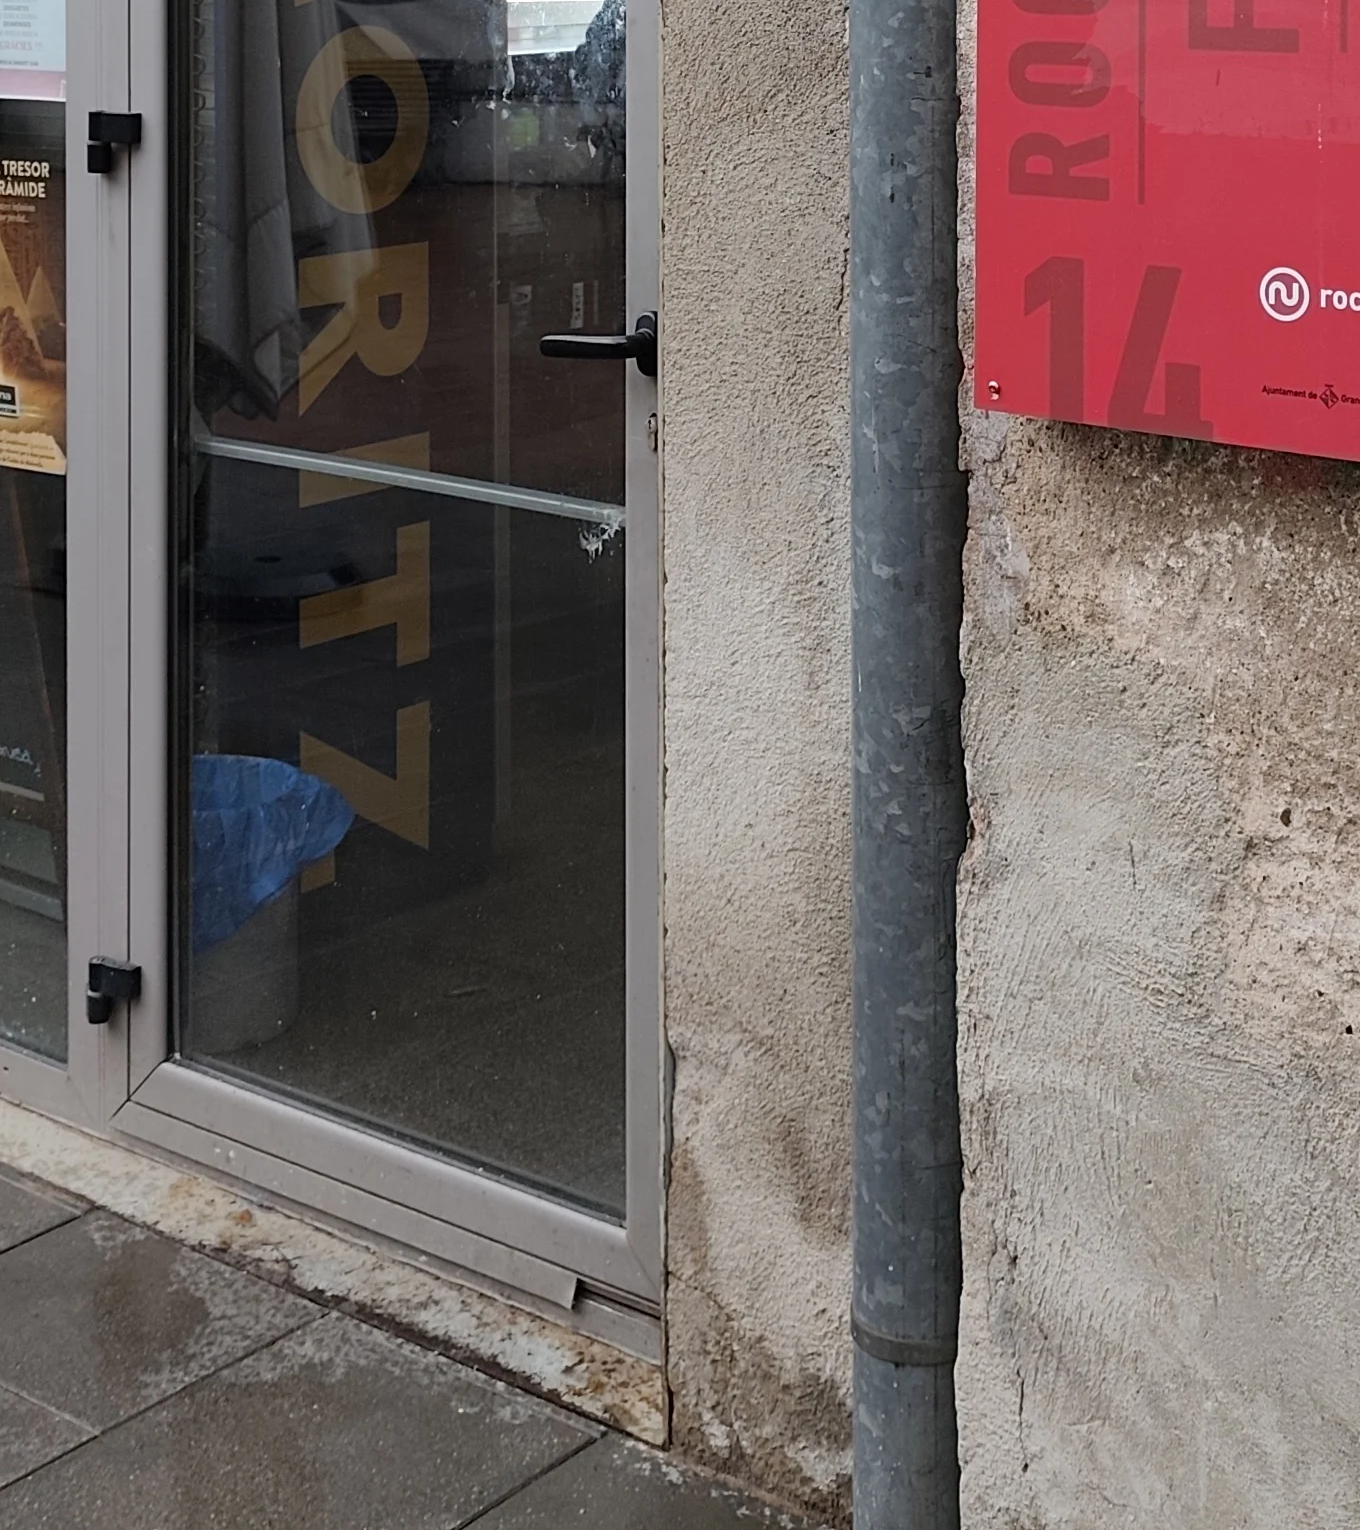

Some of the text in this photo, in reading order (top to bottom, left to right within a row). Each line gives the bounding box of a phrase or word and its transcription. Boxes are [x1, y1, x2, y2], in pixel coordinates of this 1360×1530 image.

[1, 160, 50, 178] TRESOR
[1024, 255, 1215, 439] 14
[1262, 385, 1306, 398] Ajuntament
[1308, 391, 1318, 400] de
